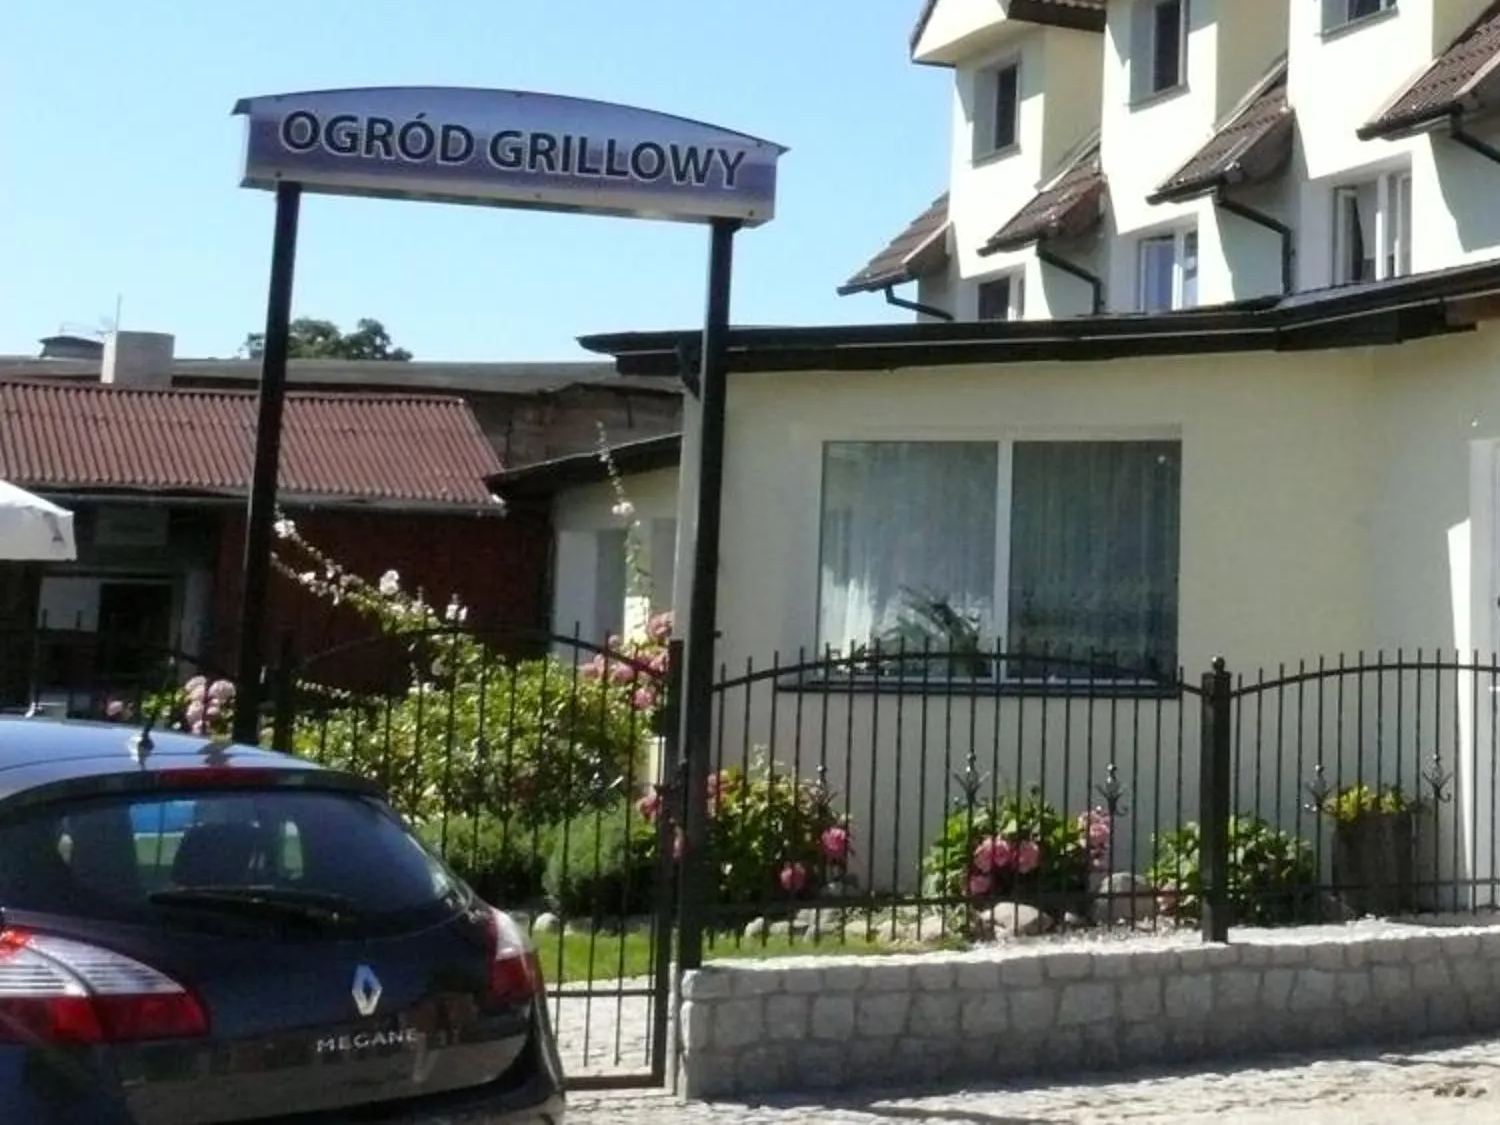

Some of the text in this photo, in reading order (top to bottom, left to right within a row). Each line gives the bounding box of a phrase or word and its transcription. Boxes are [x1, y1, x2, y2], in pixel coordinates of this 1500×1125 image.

[282, 111, 746, 188] OGRÓD GRILLOWY
[317, 1028, 418, 1052] MEGANE
